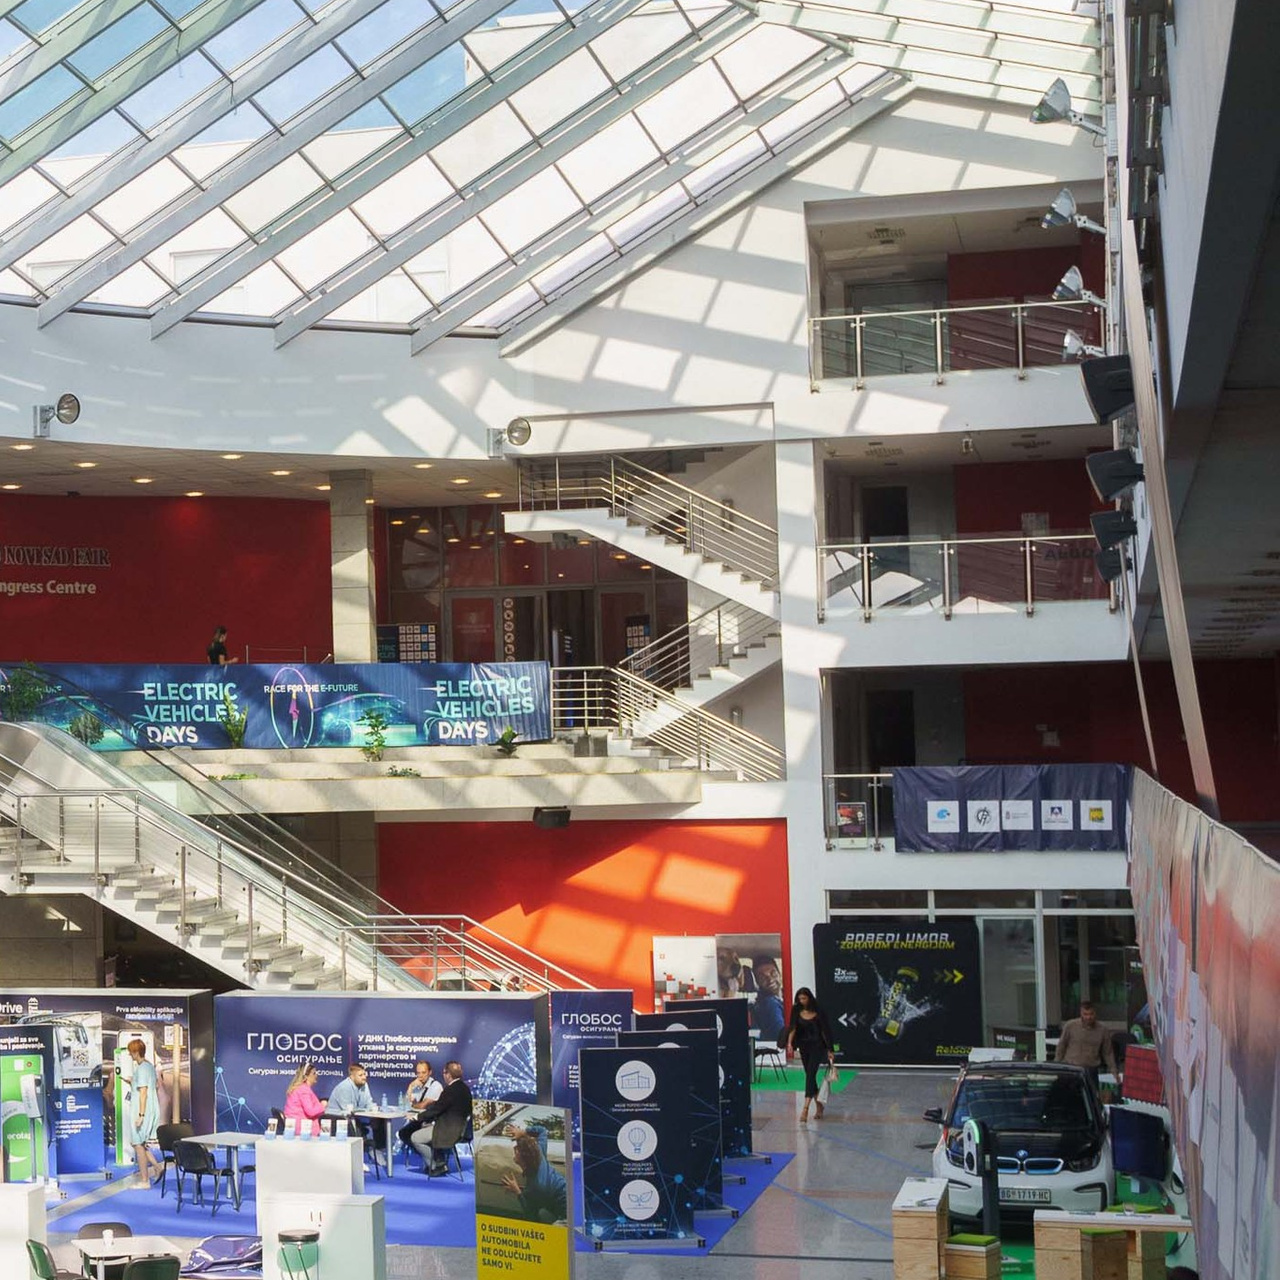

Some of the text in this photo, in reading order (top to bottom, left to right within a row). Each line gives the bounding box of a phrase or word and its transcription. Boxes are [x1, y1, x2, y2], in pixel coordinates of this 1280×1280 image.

[4, 546, 111, 567] NOVI SAD FAIR
[46, 580, 96, 594] Centre
[142, 682, 239, 701] ELECTRIC
[264, 683, 358, 693] RACE FOR THE E-FUTURE
[436, 676, 532, 698] ELECTRIC
[437, 696, 535, 718] VEHICLES
[147, 725, 198, 744] DAYS
[438, 721, 488, 740] DAYS
[840, 940, 955, 949] ZDRAVOM ENERGIJOM
[561, 1013, 622, 1025] ГЛОБОС
[247, 1032, 342, 1052] ГЛОБОС
[365, 1035, 383, 1043] ДНК
[384, 1035, 412, 1043] Глобос
[276, 1054, 342, 1064] ОСИГУРАЊЕ
[358, 1053, 409, 1061] партнерство
[248, 1067, 278, 1076] Сигуран
[481, 1223, 545, 1241] O SUDBINI VAŠEG
[481, 1235, 531, 1251] AUTOMOBILA
[481, 1247, 542, 1264] NE ODLUČUJETE
[482, 1258, 503, 1270] SAMO
